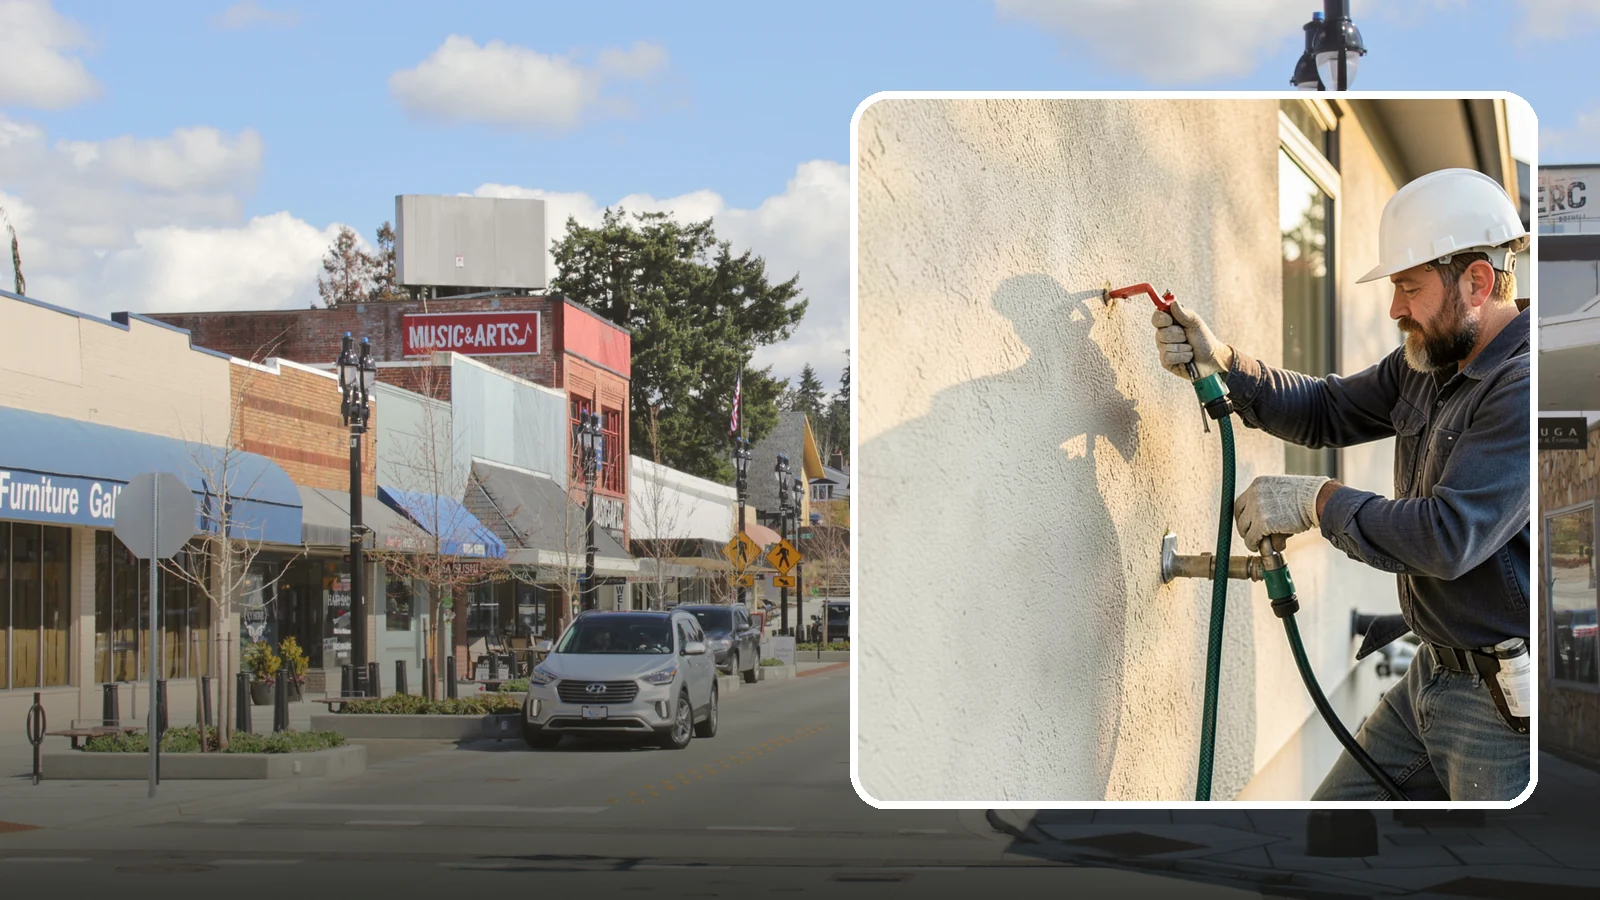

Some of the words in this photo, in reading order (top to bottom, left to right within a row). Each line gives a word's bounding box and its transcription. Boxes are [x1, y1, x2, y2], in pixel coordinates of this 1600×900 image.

[0, 471, 79, 515] Furniture
[89, 482, 122, 520] Gal
[453, 563, 479, 574] SUSHI
